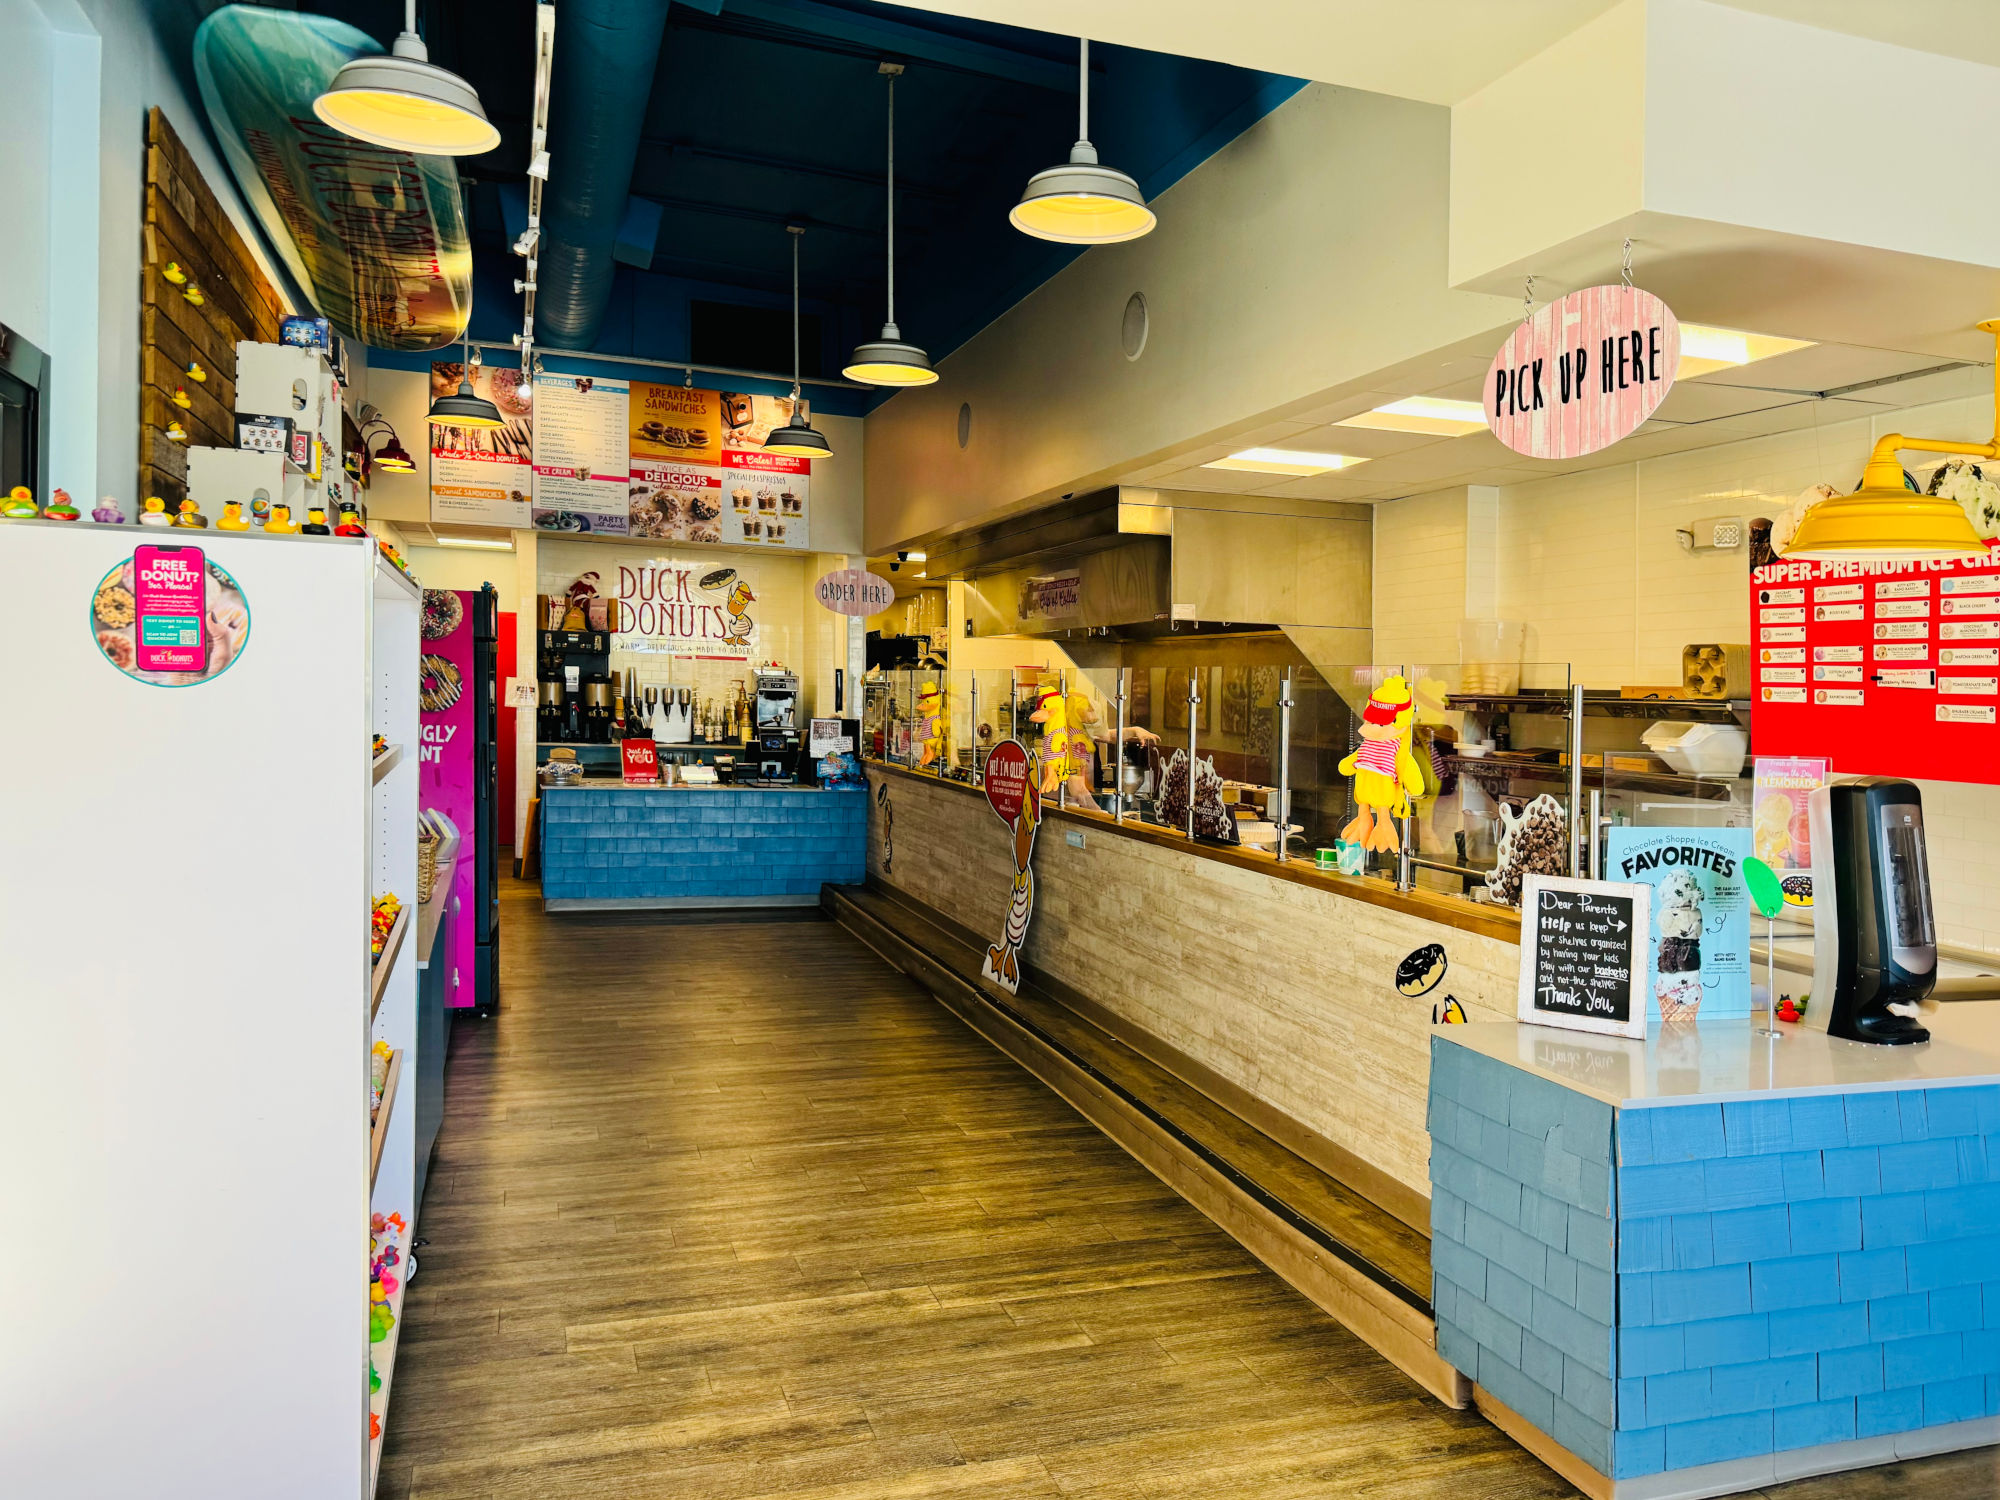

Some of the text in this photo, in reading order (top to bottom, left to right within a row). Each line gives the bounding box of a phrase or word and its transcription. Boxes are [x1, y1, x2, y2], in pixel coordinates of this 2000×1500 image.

[1496, 327, 1660, 418] PICK UP HERE
[649, 387, 704, 403] BREAKFAST
[644, 399, 707, 415] SANDWICHES
[439, 450, 520, 464] Made-To-Order DONUTS
[732, 454, 744, 464] WE
[552, 468, 572, 476] CREAM
[657, 464, 697, 474] TWICE AS
[645, 471, 708, 486] DELICIOUS
[598, 515, 624, 523] PARTY
[152, 559, 188, 571] FREE
[1753, 560, 1914, 584] SUPER-PREMIUM
[1920, 559, 1954, 572] ICE
[141, 569, 200, 583] DONUT?
[165, 580, 193, 590] Please!
[619, 566, 692, 603] DUCK
[821, 582, 887, 604] ORDER HERE
[619, 601, 727, 639] DONUTS
[647, 643, 684, 652] DELICIOUS
[696, 645, 714, 653] MADE
[718, 646, 726, 654] TO
[150, 654, 166, 662] DUCK
[172, 655, 194, 663] DONUTS
[627, 754, 654, 764] YOU
[989, 757, 1026, 779] HI! I'M OLLIE!
[1763, 777, 1817, 788] LEMONADE
[1622, 834, 1735, 858] Chocolate Shoppe Ice Cream
[1620, 846, 1737, 879] FAVORITES
[1540, 890, 1618, 915] Dear Parents
[1541, 916, 1609, 934] Help us keep
[1541, 934, 1627, 951] our shelves organized
[1541, 947, 1620, 964] by having your kids
[1558, 963, 1575, 973] with
[1578, 964, 1591, 973] our
[1594, 963, 1629, 979] baskets
[1540, 973, 1553, 984] and
[1557, 975, 1570, 985] not
[1571, 974, 1587, 986] the
[1538, 983, 1615, 1013] Thank You
